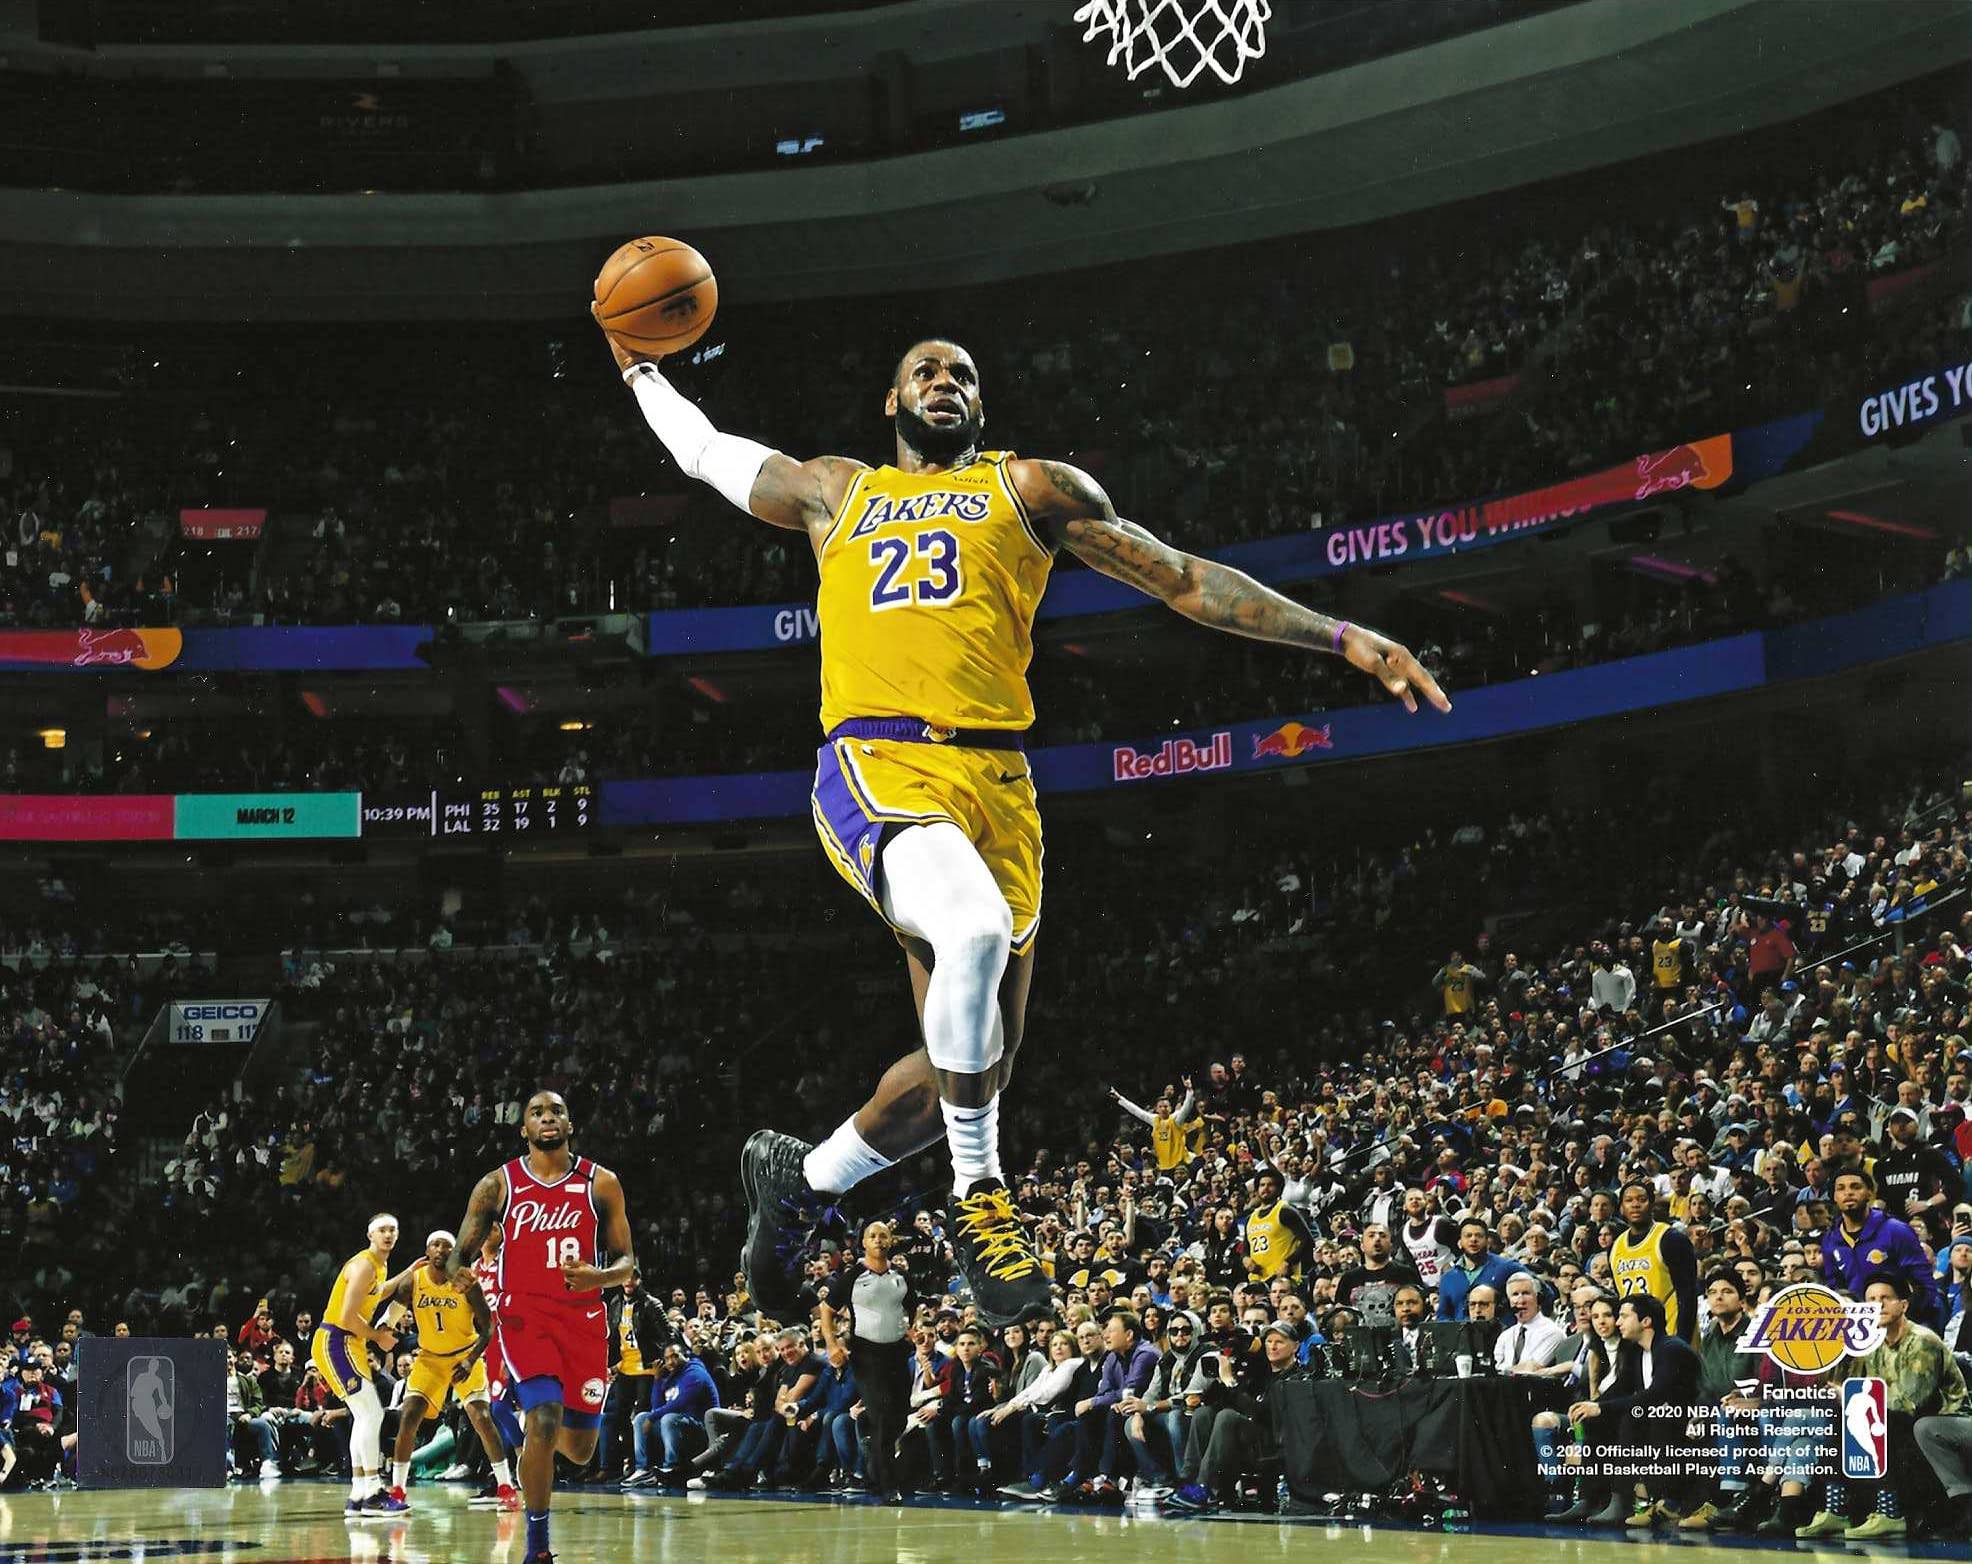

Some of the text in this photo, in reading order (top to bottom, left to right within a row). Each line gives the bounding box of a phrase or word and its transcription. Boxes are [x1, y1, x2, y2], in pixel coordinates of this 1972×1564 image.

[1860, 375, 1939, 437] GIVES
[848, 492, 990, 542] LAKERS
[1327, 520, 1409, 567] GIVES
[1416, 506, 1477, 550] YOU
[869, 529, 961, 611] 23
[237, 807, 295, 824] MARCH 12
[363, 805, 432, 822] 10:39 PM
[445, 798, 588, 818] PHI 35 17 2 9
[444, 813, 588, 833] LAL 32 19 1 9
[184, 1005, 257, 1020] GEICO
[177, 1025, 203, 1040] 118
[1909, 1188, 1919, 1202] 6
[511, 1200, 582, 1240] Phila
[546, 1236, 580, 1268] 18
[1251, 1235, 1269, 1253] 23
[435, 1311, 444, 1332] 1
